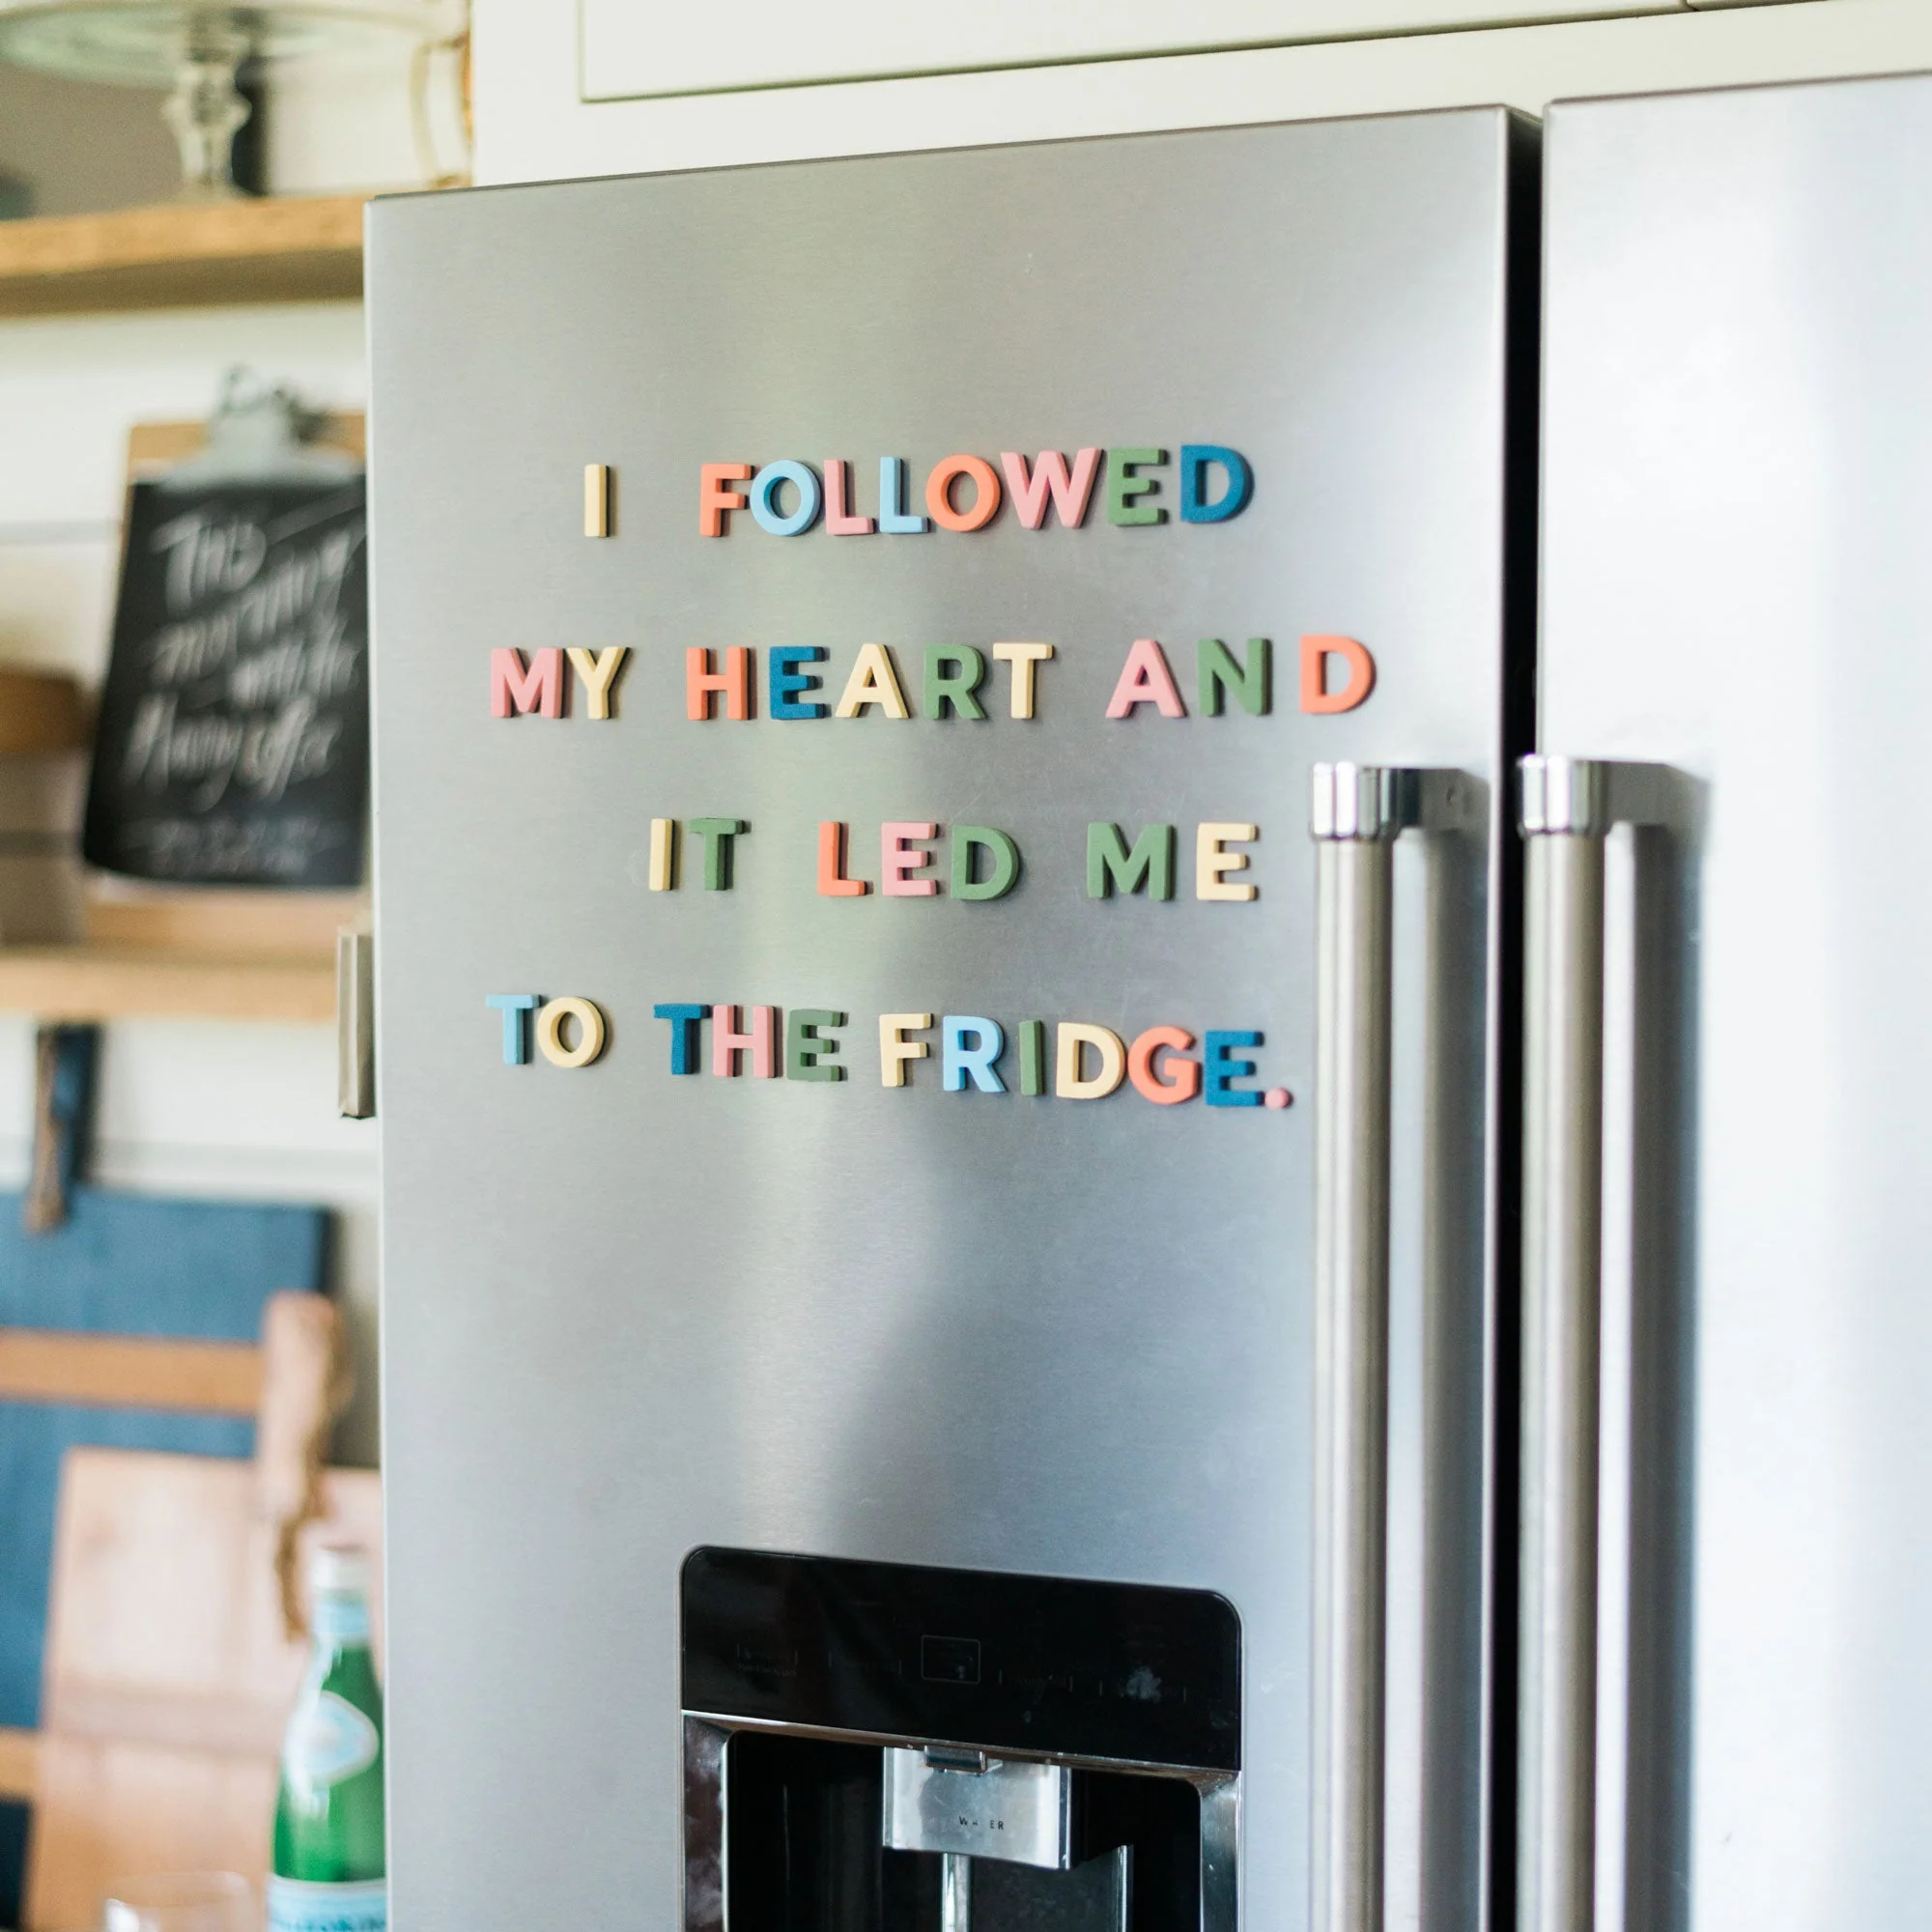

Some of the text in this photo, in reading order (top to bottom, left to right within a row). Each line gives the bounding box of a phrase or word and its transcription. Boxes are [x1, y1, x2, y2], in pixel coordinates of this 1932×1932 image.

[584, 444, 1252, 537] I FOLLOWED
[491, 634, 1377, 720] MY HEART AND
[649, 817, 1259, 901] IT LED ME
[486, 994, 1293, 1106] TO THE FRIDGE.
[958, 1815, 1005, 1830] WER
